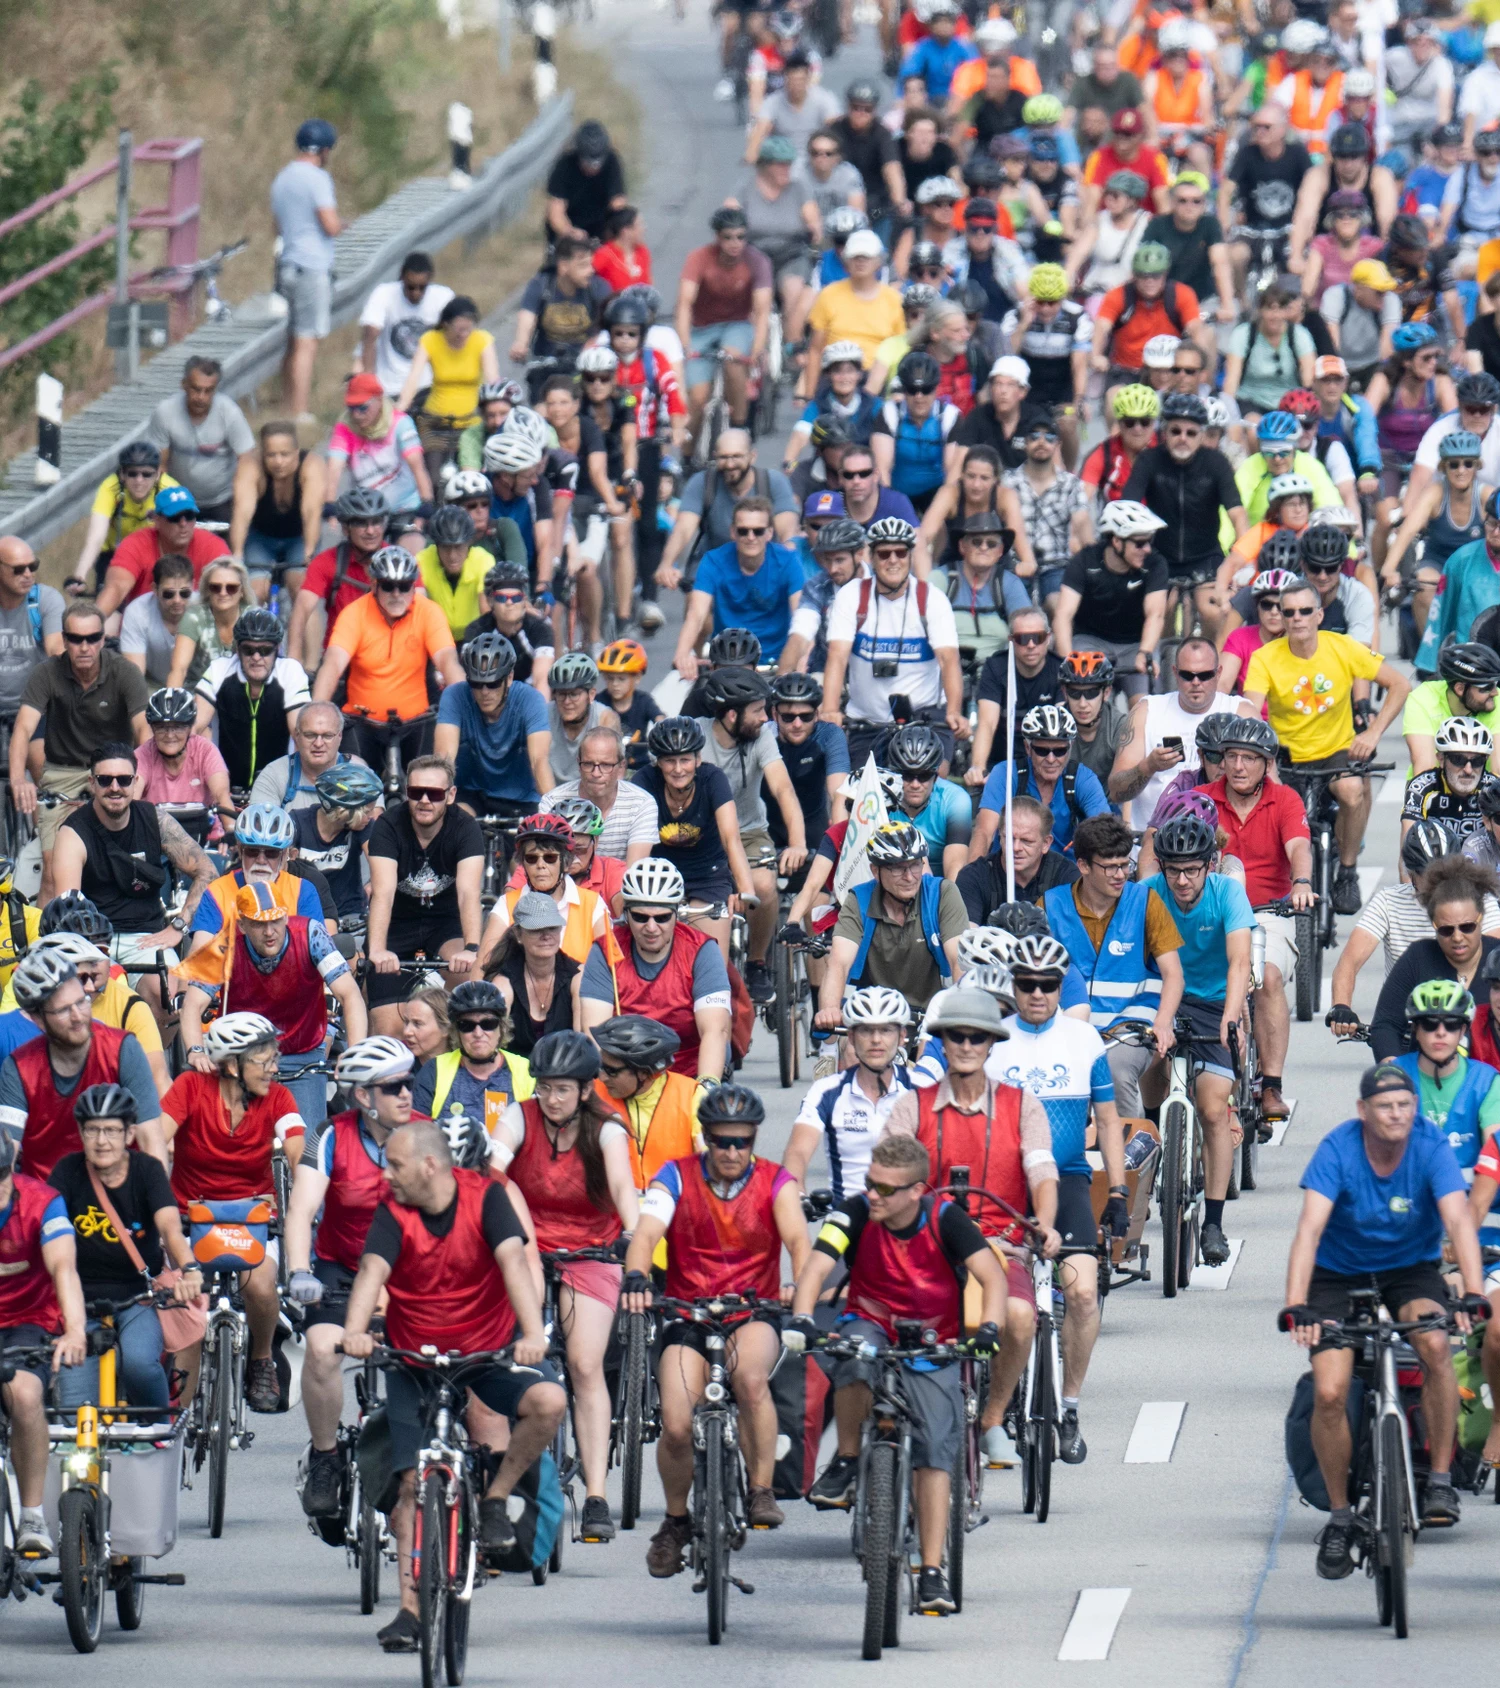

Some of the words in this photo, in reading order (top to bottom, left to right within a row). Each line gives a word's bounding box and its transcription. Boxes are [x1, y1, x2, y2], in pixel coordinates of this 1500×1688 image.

[705, 995, 727, 1005] Ordner
[852, 1109, 868, 1118] OPEN
[215, 1228, 242, 1237] ADFC-
[223, 1236, 254, 1248] Tour
